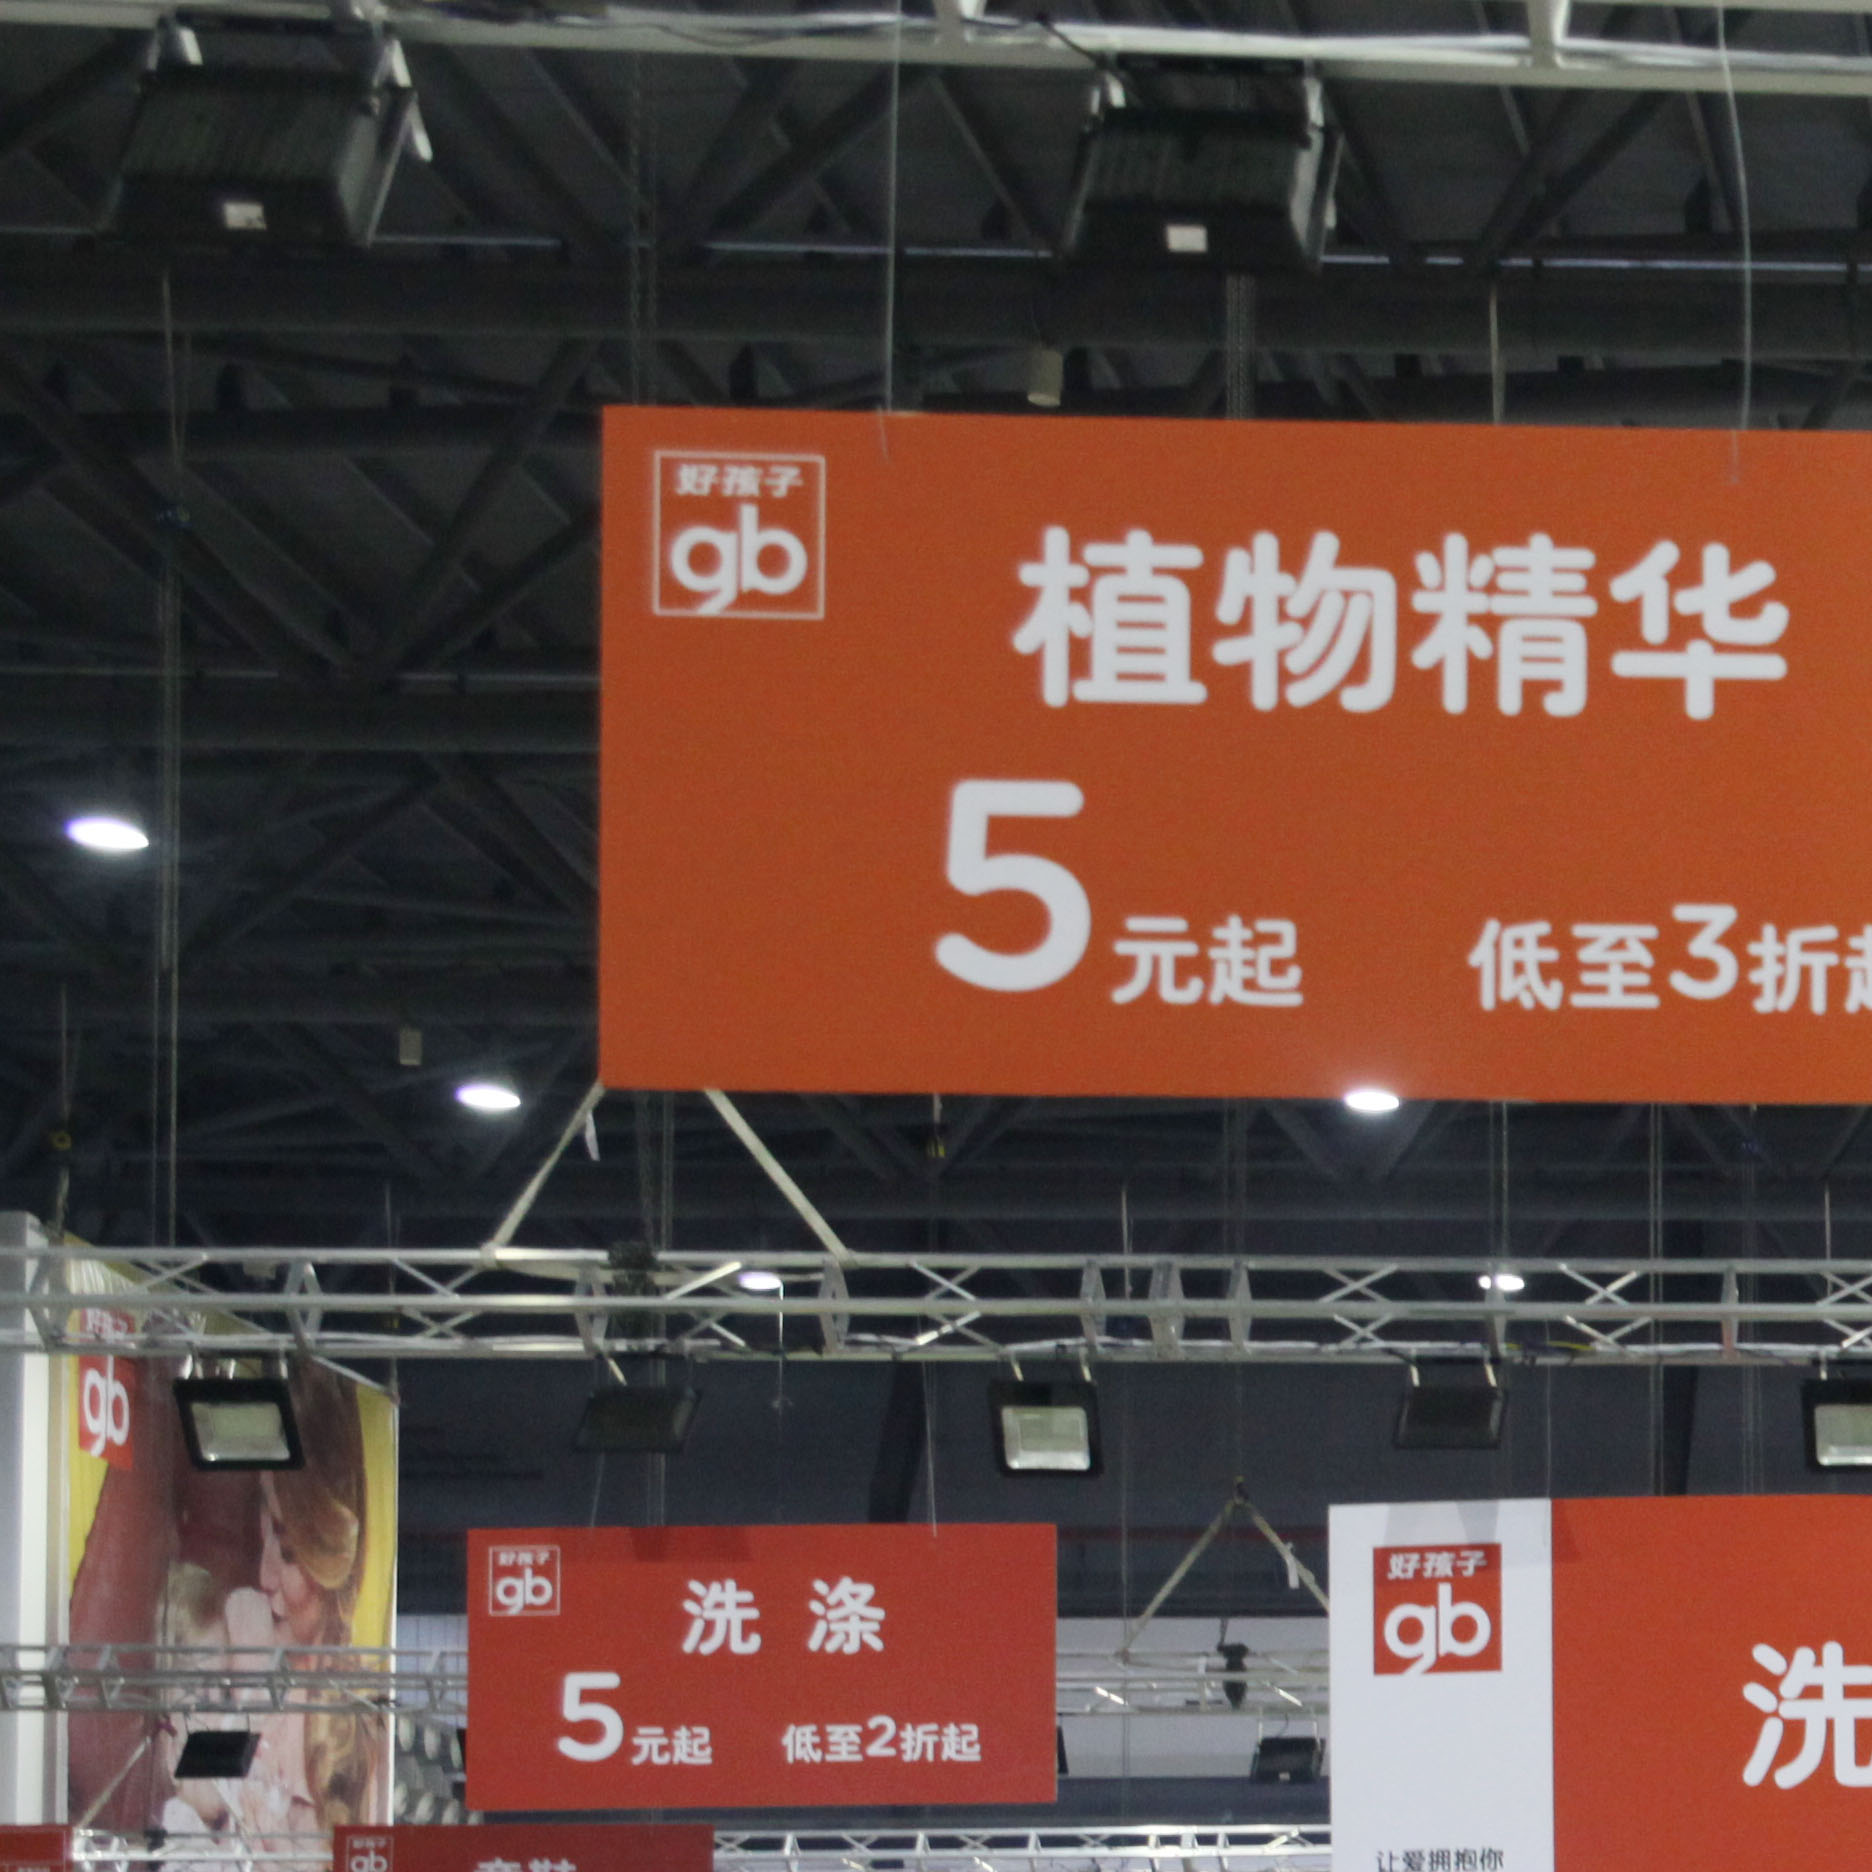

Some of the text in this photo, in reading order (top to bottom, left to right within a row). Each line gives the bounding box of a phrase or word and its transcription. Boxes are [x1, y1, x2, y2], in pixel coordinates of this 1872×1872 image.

[676, 462, 804, 497] 好孩子
[669, 503, 808, 613] gb
[1013, 527, 1789, 720] 植物精华
[936, 780, 1303, 1006] 5元起
[494, 1568, 553, 1613] gb
[1387, 1550, 1484, 1580] 好孩子
[682, 1577, 885, 1655] 洗涤
[1383, 1582, 1493, 1674] gb
[558, 1672, 981, 1765] 5元起 低至2折起
